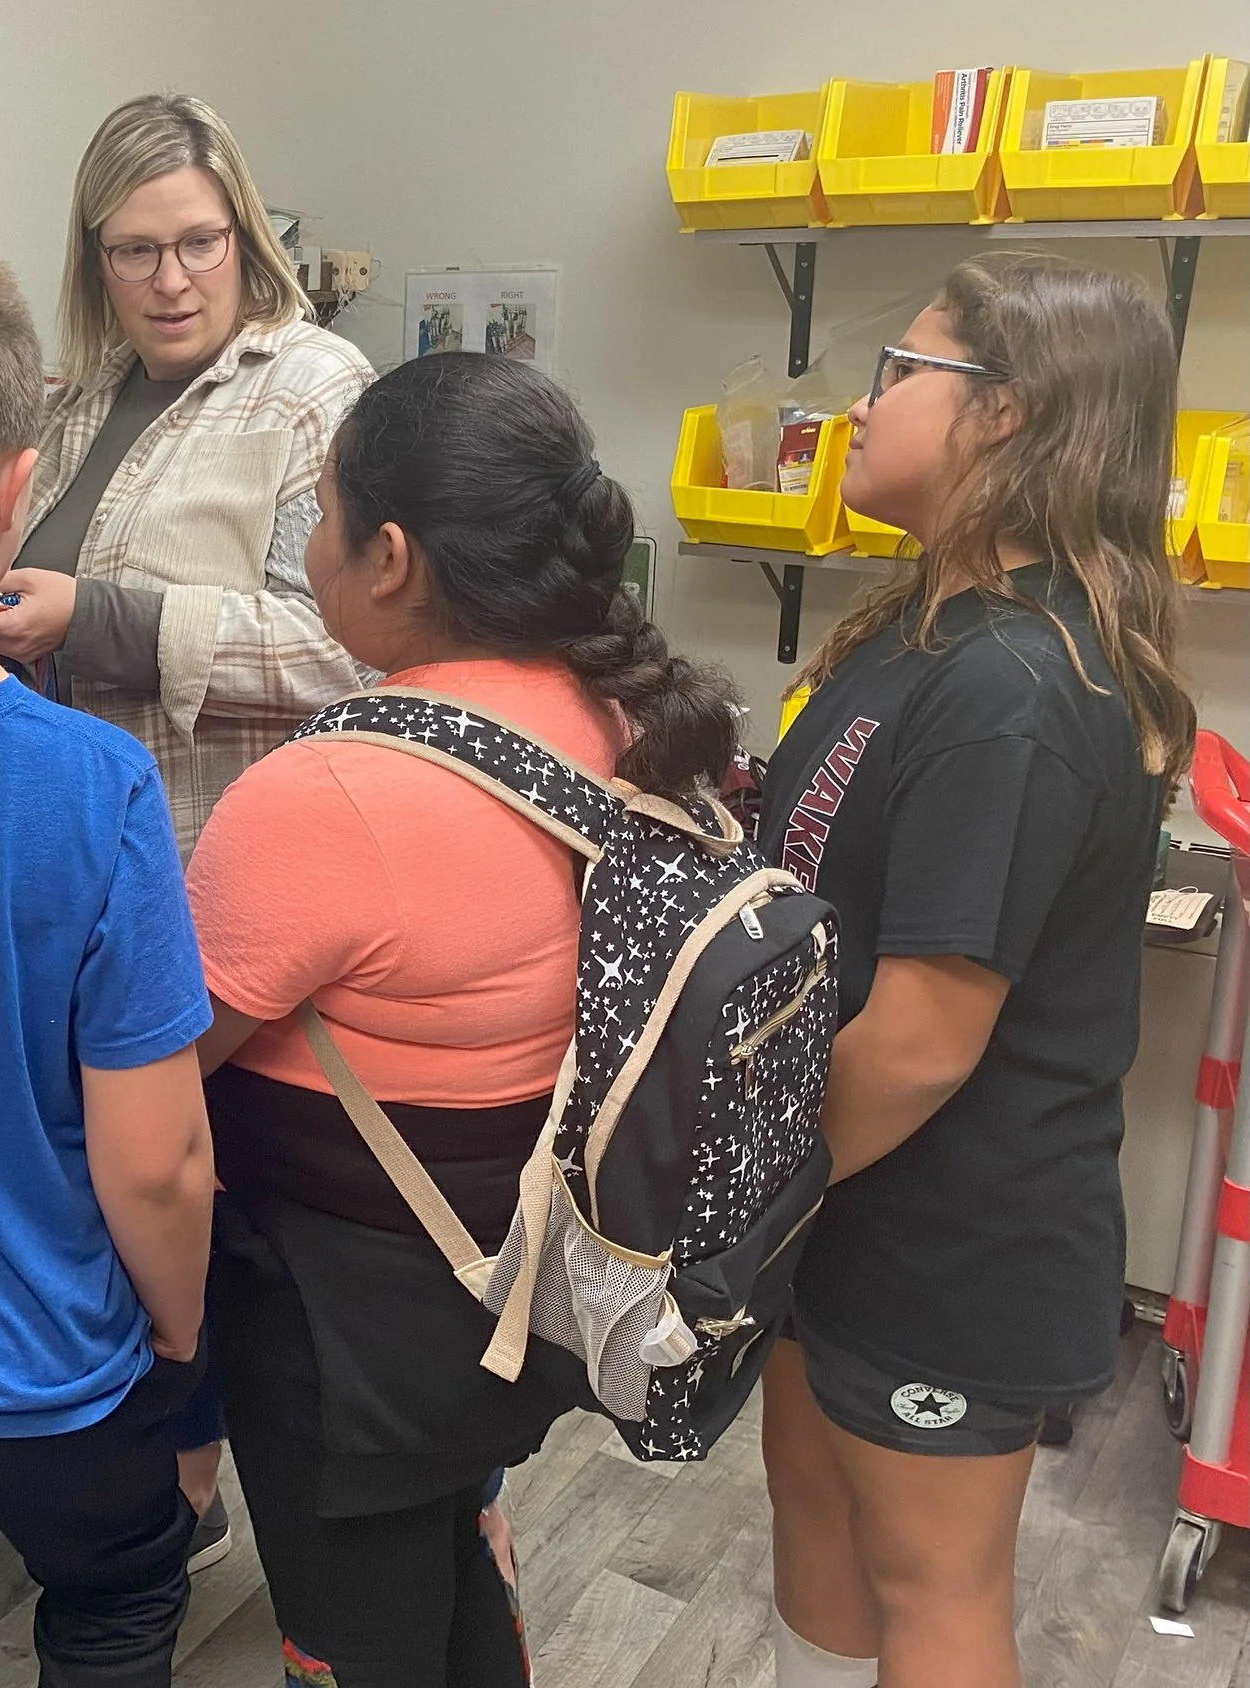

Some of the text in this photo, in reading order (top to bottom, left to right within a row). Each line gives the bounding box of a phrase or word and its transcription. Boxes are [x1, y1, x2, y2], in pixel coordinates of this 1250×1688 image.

[959, 73, 968, 100] Arthritis
[958, 101, 966, 117] Pain
[956, 117, 965, 145] Reliever
[426, 292, 456, 300] WRONG
[501, 291, 524, 299] RIGHT
[903, 1412, 953, 1425] ALL STAR
